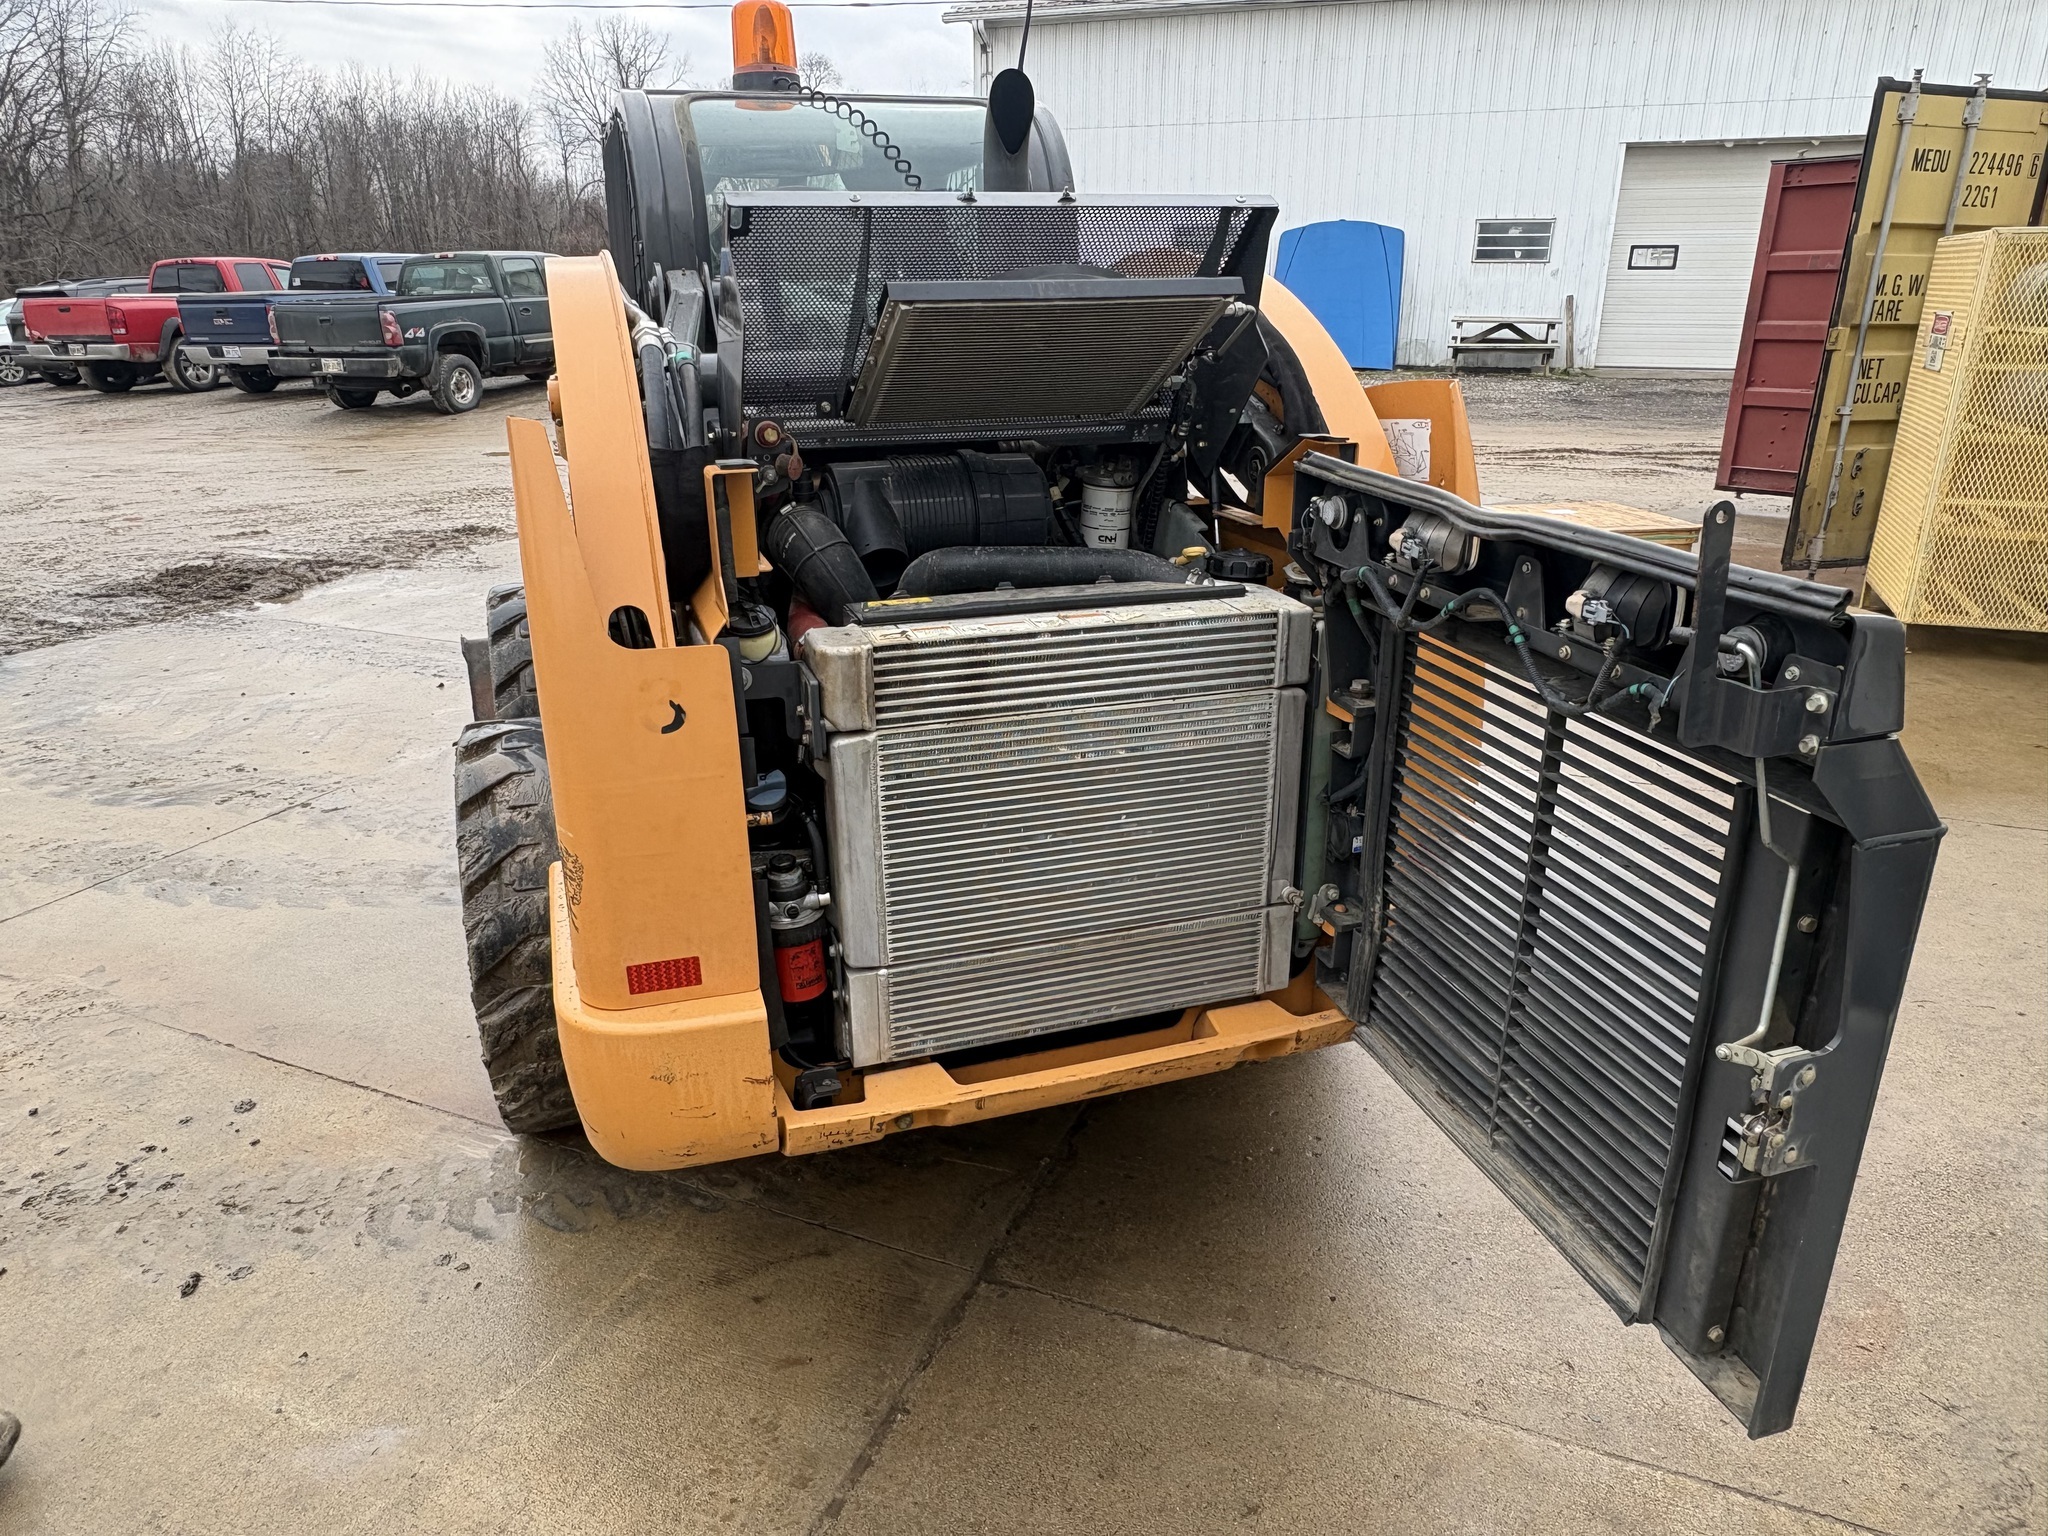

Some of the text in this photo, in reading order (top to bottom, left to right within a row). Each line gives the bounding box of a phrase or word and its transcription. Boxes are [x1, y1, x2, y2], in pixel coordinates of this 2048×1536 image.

[1911, 148, 2040, 178] MEDU 224496 6
[1962, 185, 1998, 208] 22G1
[1857, 358, 1885, 381] NET
[1097, 533, 1118, 543] CNH
